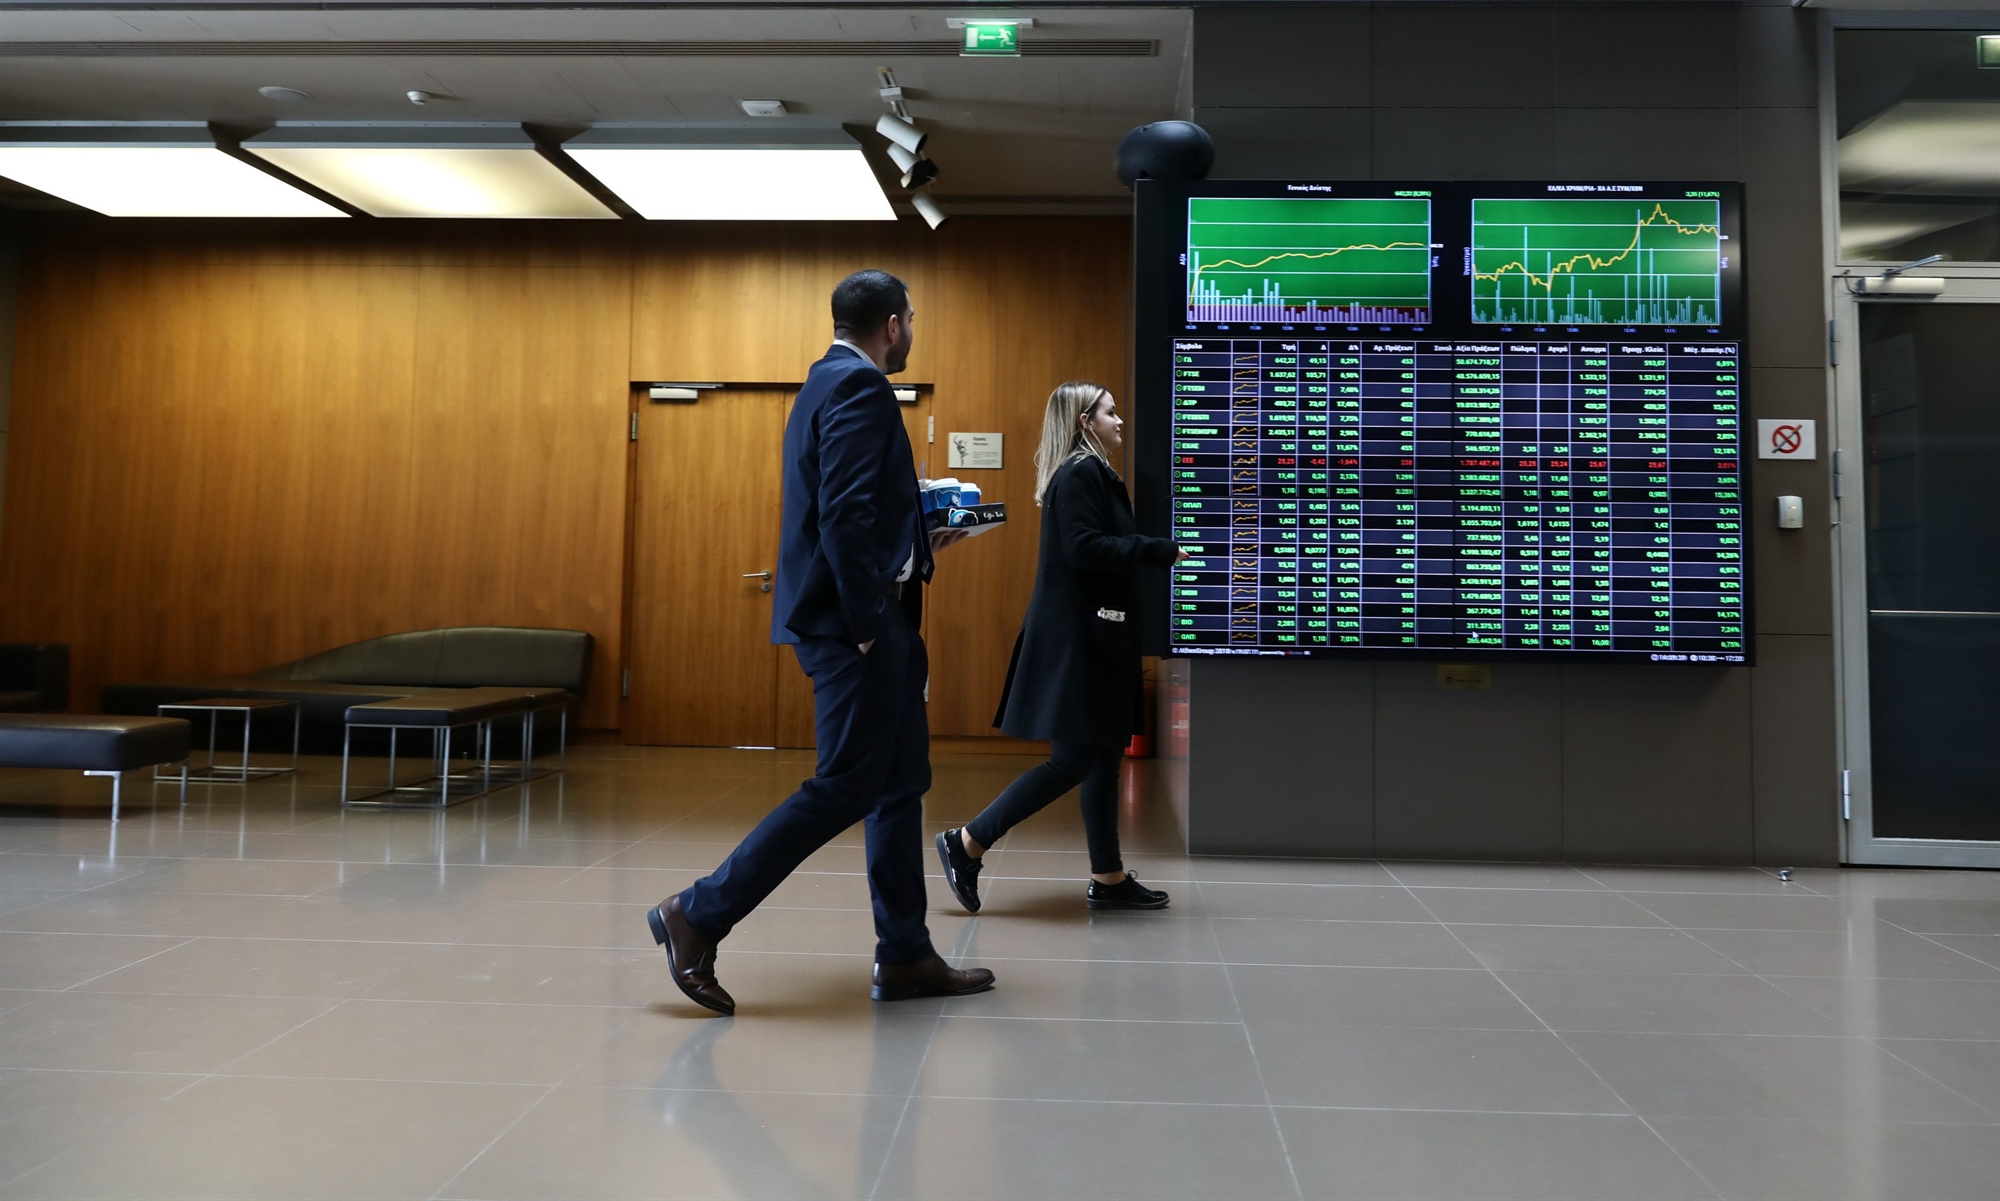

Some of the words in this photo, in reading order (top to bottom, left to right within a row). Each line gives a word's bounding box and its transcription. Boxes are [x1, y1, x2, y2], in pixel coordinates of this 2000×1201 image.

[1287, 184, 1309, 192] Γενικός
[1309, 184, 1332, 192] Δείκτης
[1281, 343, 1296, 351] Τιμή
[1456, 344, 1471, 352] Αξία
[1471, 345, 1500, 353] Πράξεων
